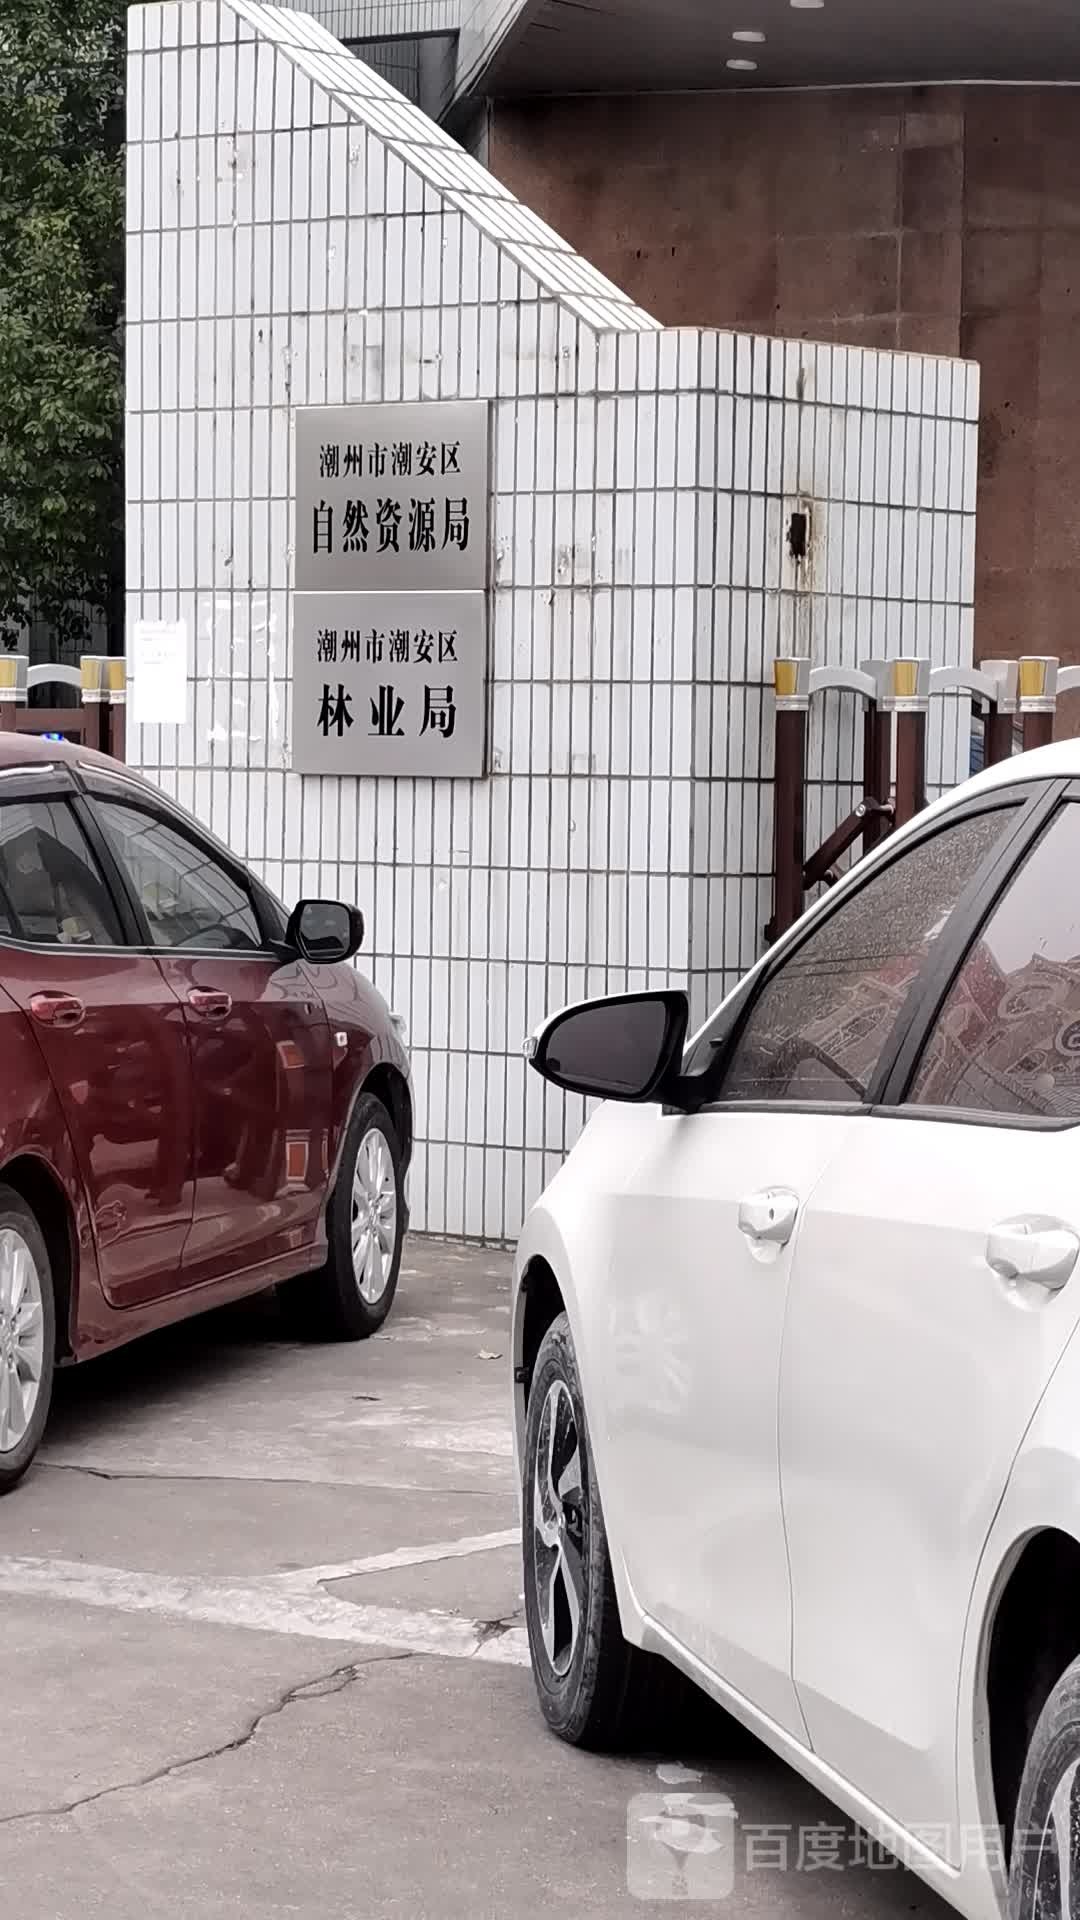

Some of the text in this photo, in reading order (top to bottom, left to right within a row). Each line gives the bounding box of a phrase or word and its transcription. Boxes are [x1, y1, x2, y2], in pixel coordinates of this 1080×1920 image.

[319, 441, 461, 478] 潮州市潮安区
[312, 497, 469, 553] 自然资源局
[316, 629, 458, 663] 潮州市潮安区
[316, 684, 457, 738] 林业局
